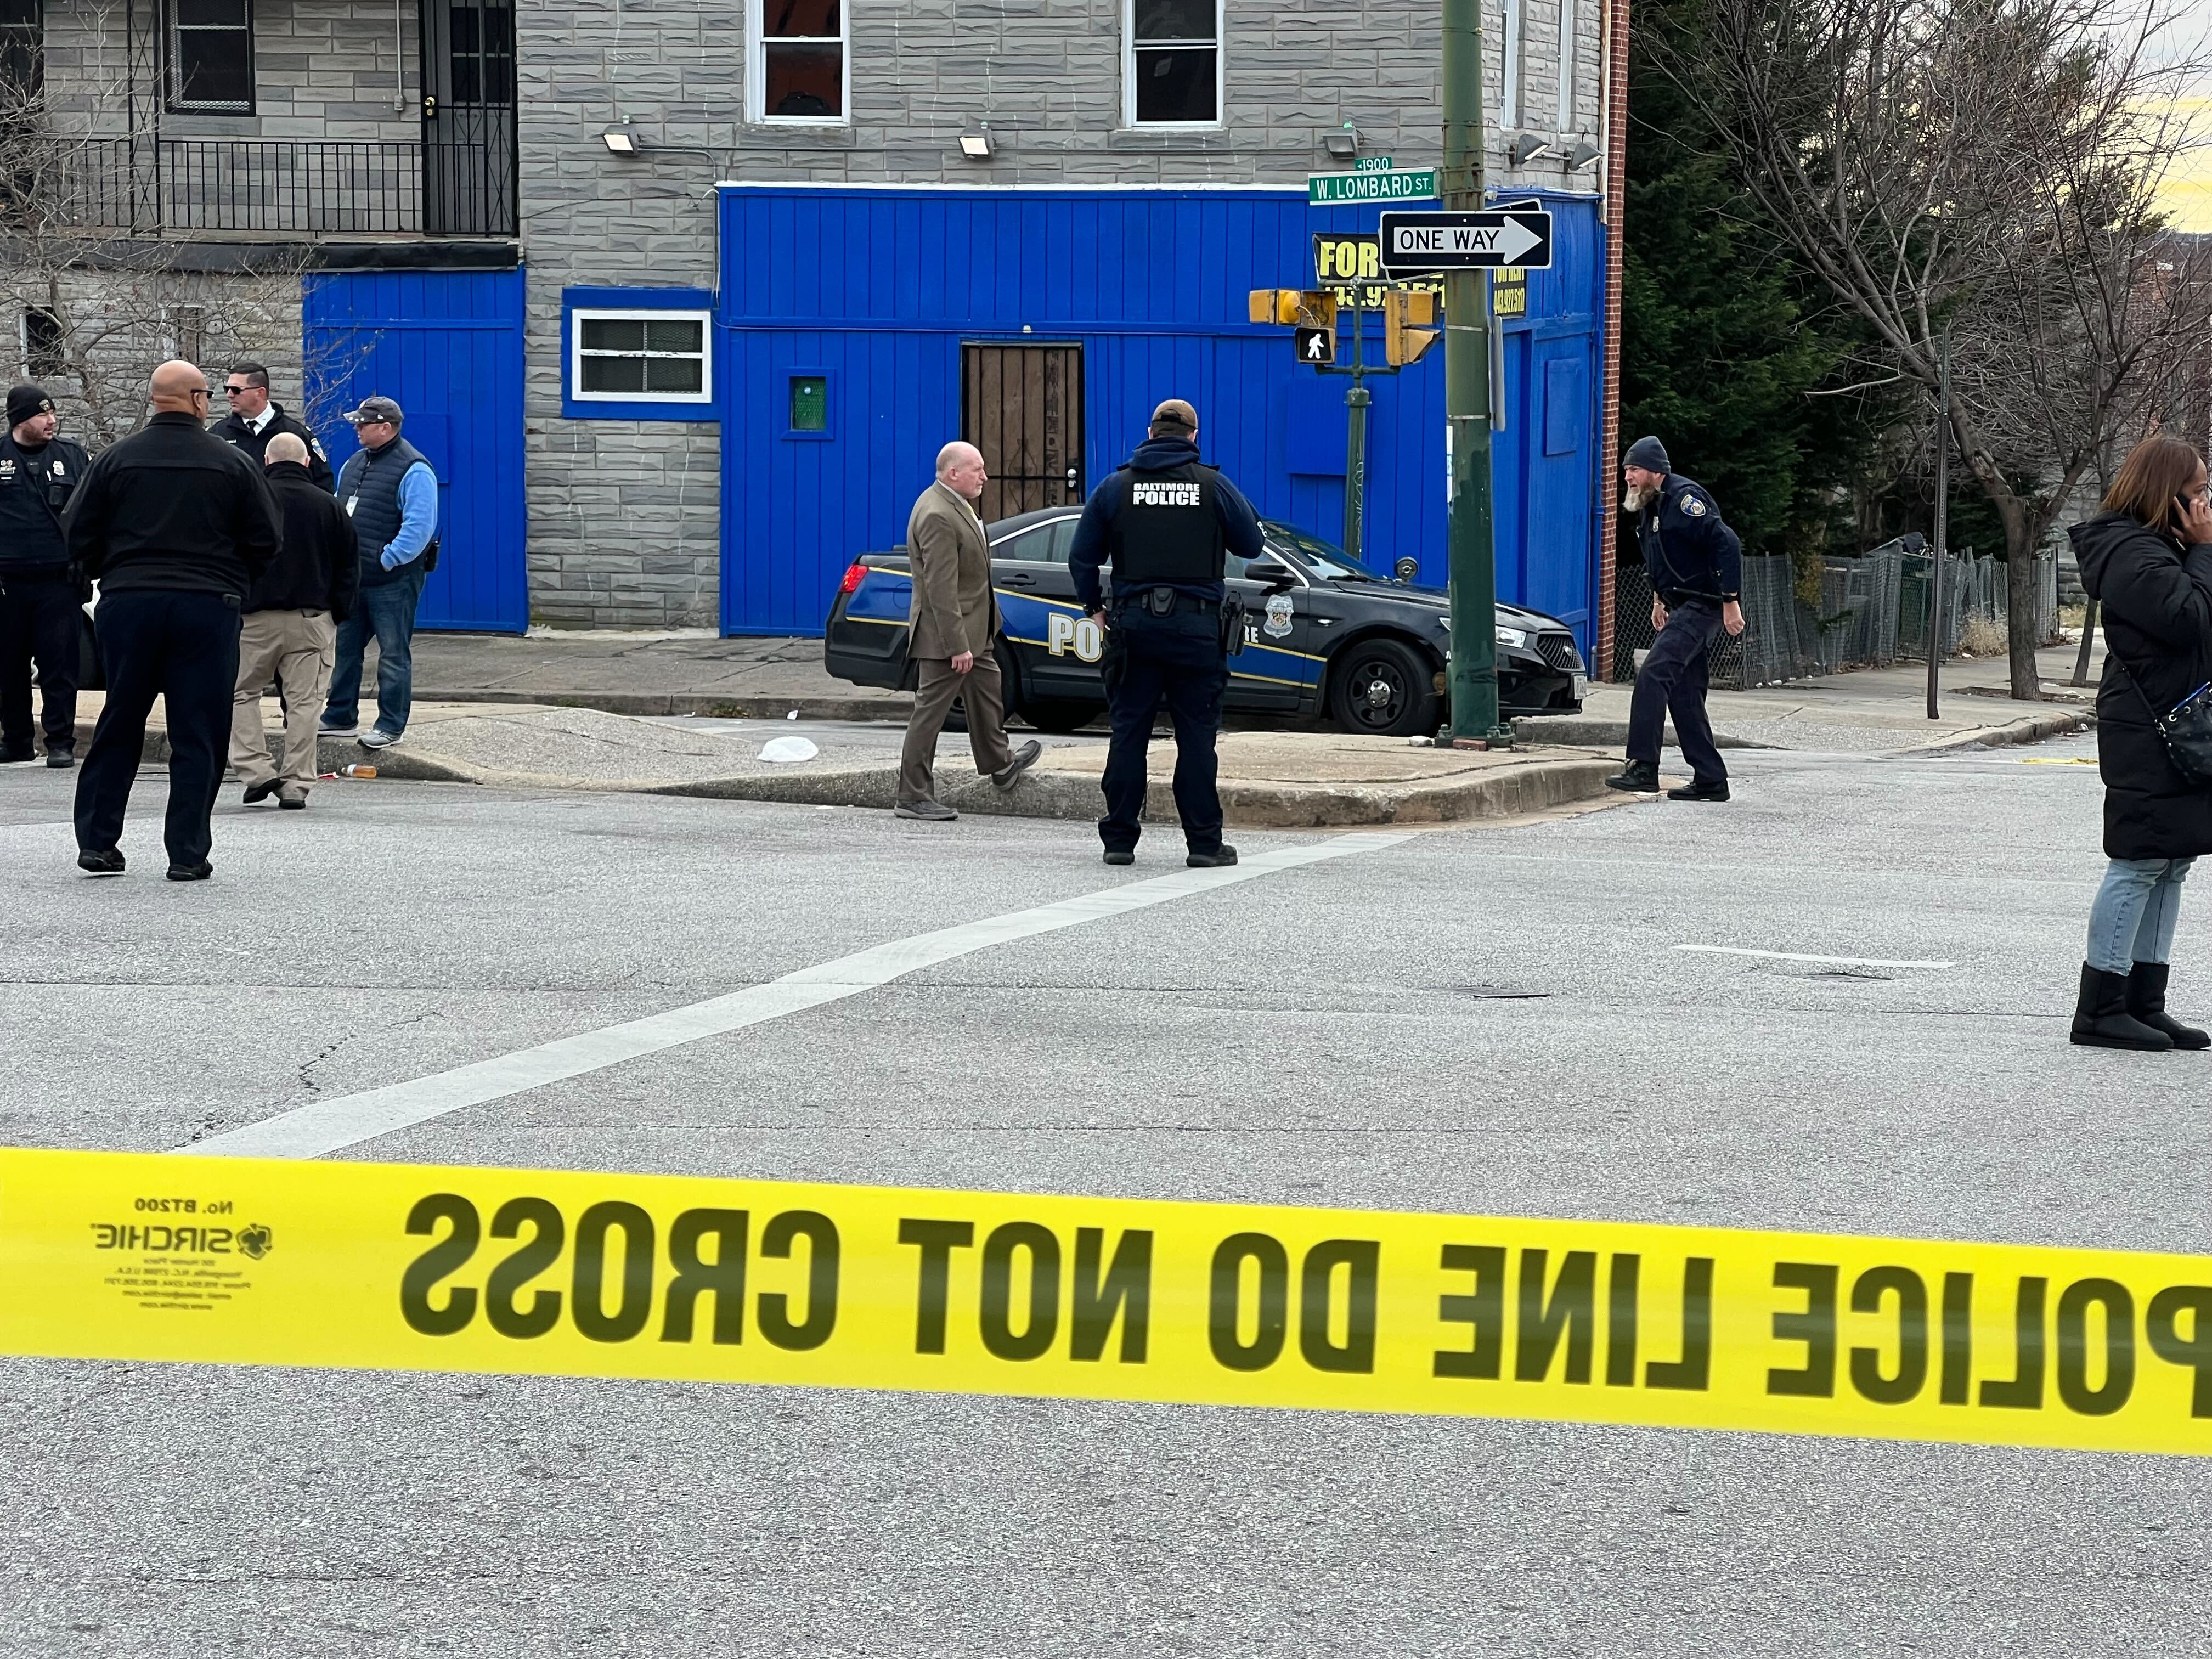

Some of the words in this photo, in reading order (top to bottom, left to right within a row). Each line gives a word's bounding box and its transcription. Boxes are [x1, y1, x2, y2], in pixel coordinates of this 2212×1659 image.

[1363, 157, 1389, 171] 1900
[1316, 179, 1332, 199] W.
[1336, 176, 1412, 199] LOMBARD
[1415, 177, 1431, 190] ST.
[1400, 229, 1444, 250] ONE
[1453, 229, 1500, 250] WAY
[1319, 241, 1379, 278] FOR
[1133, 483, 1200, 492] BALTIMORE
[1133, 490, 1200, 505] POLICE
